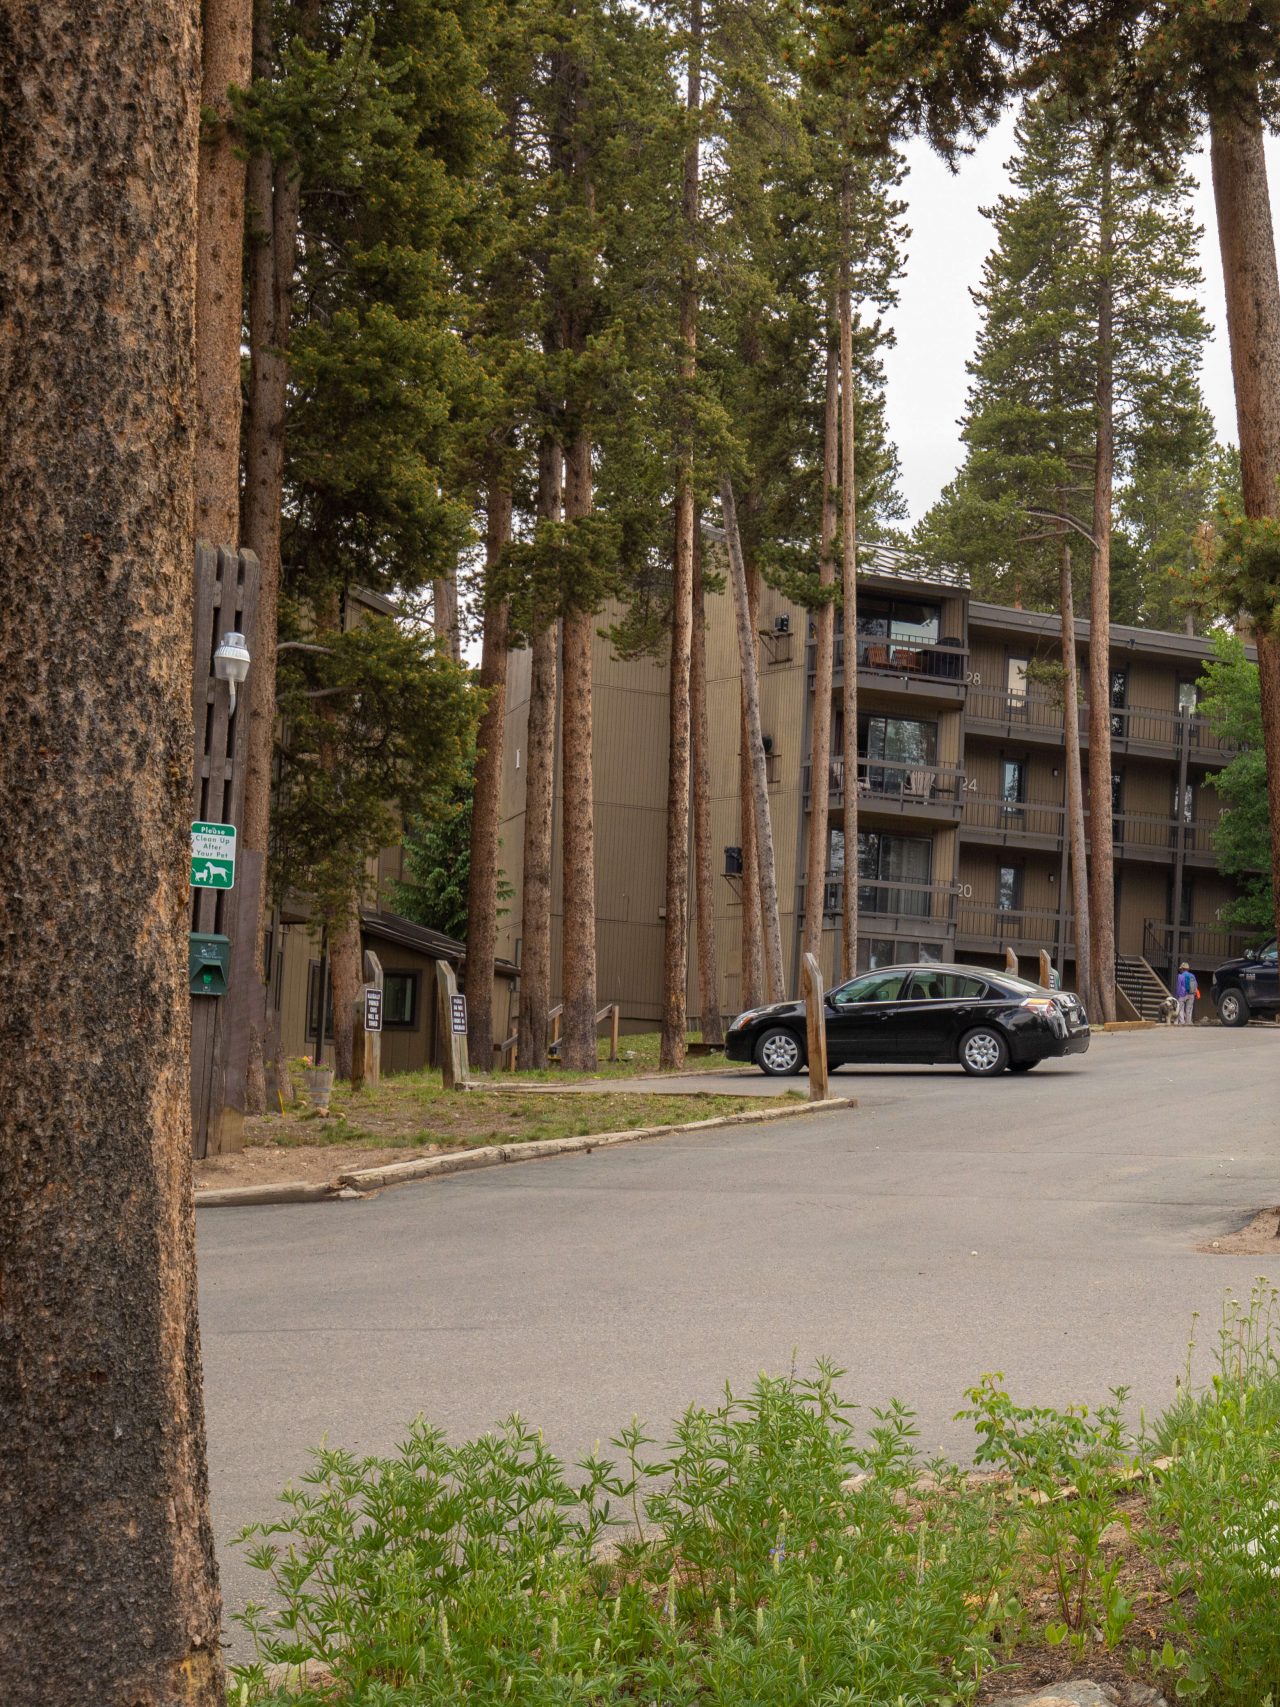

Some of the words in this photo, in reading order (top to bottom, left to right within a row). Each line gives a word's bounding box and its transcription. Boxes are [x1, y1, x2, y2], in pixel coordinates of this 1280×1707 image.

[966, 671, 981, 686] 28
[962, 777, 977, 792] 24
[201, 826, 225, 835] Please
[195, 835, 217, 843] Clean
[220, 836, 230, 845] Up
[216, 851, 228, 859] Pet
[957, 883, 972, 898] 20
